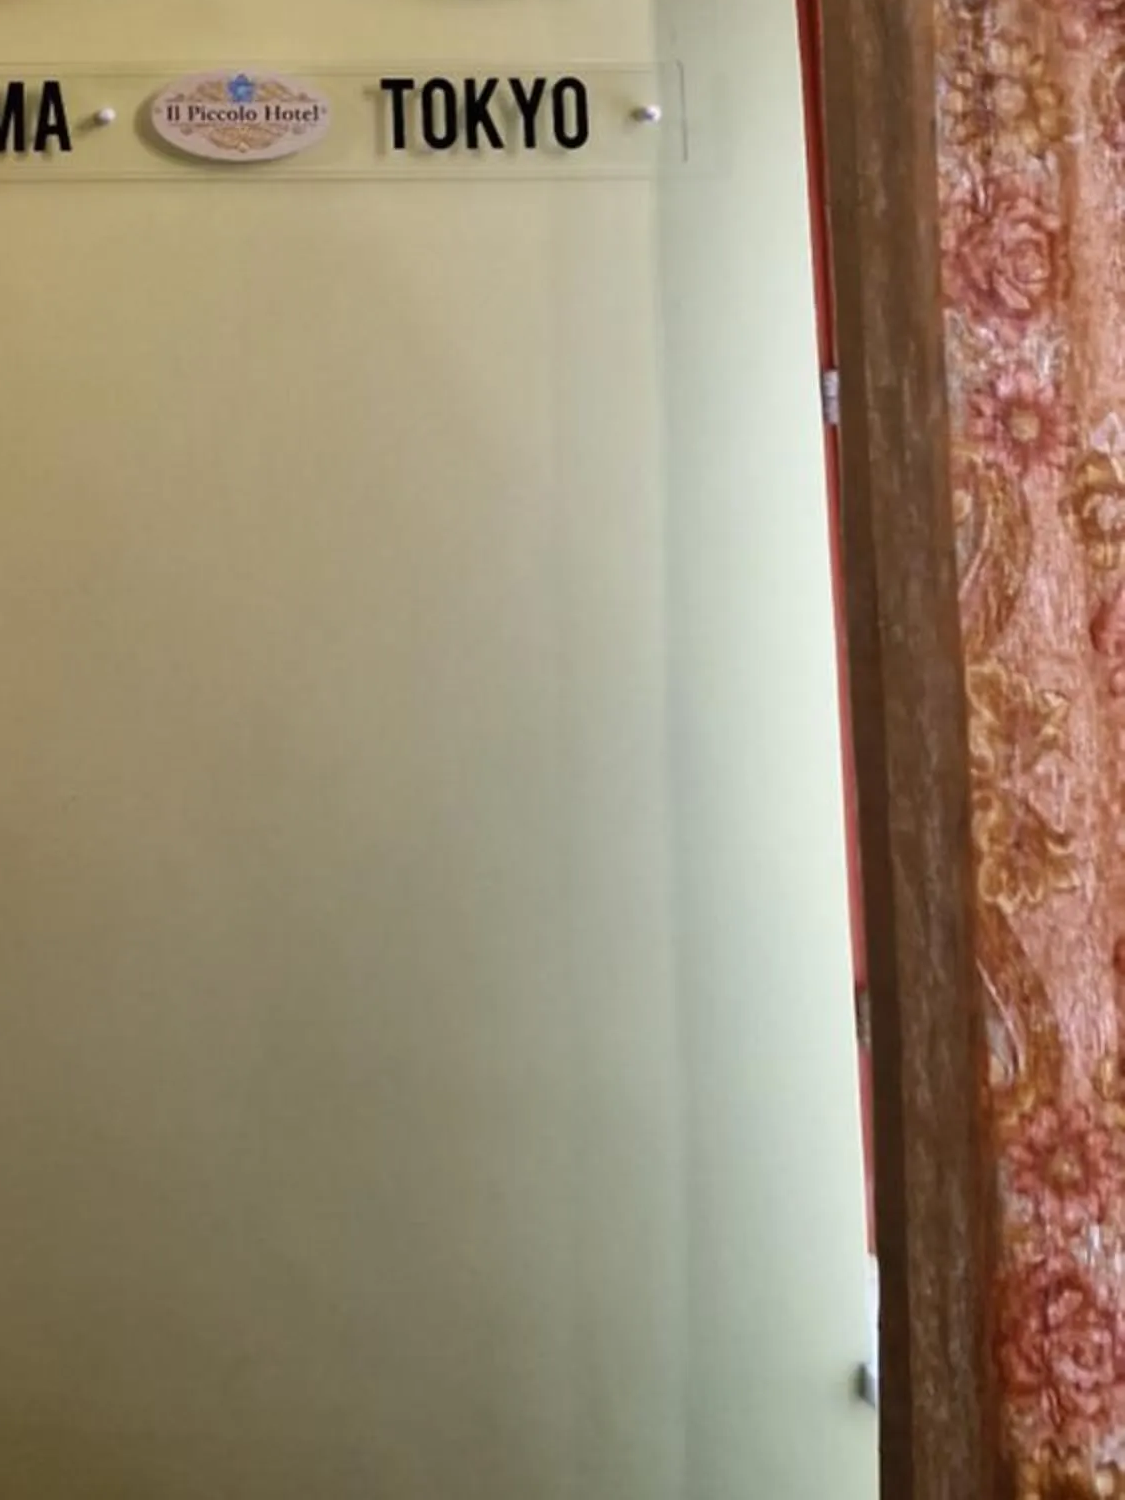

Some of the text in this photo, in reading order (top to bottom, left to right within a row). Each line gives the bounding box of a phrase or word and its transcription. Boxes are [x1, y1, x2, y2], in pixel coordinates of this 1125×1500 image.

[166, 104, 319, 122] Il Piccolo Hotel
[380, 77, 589, 149] TOKYO
